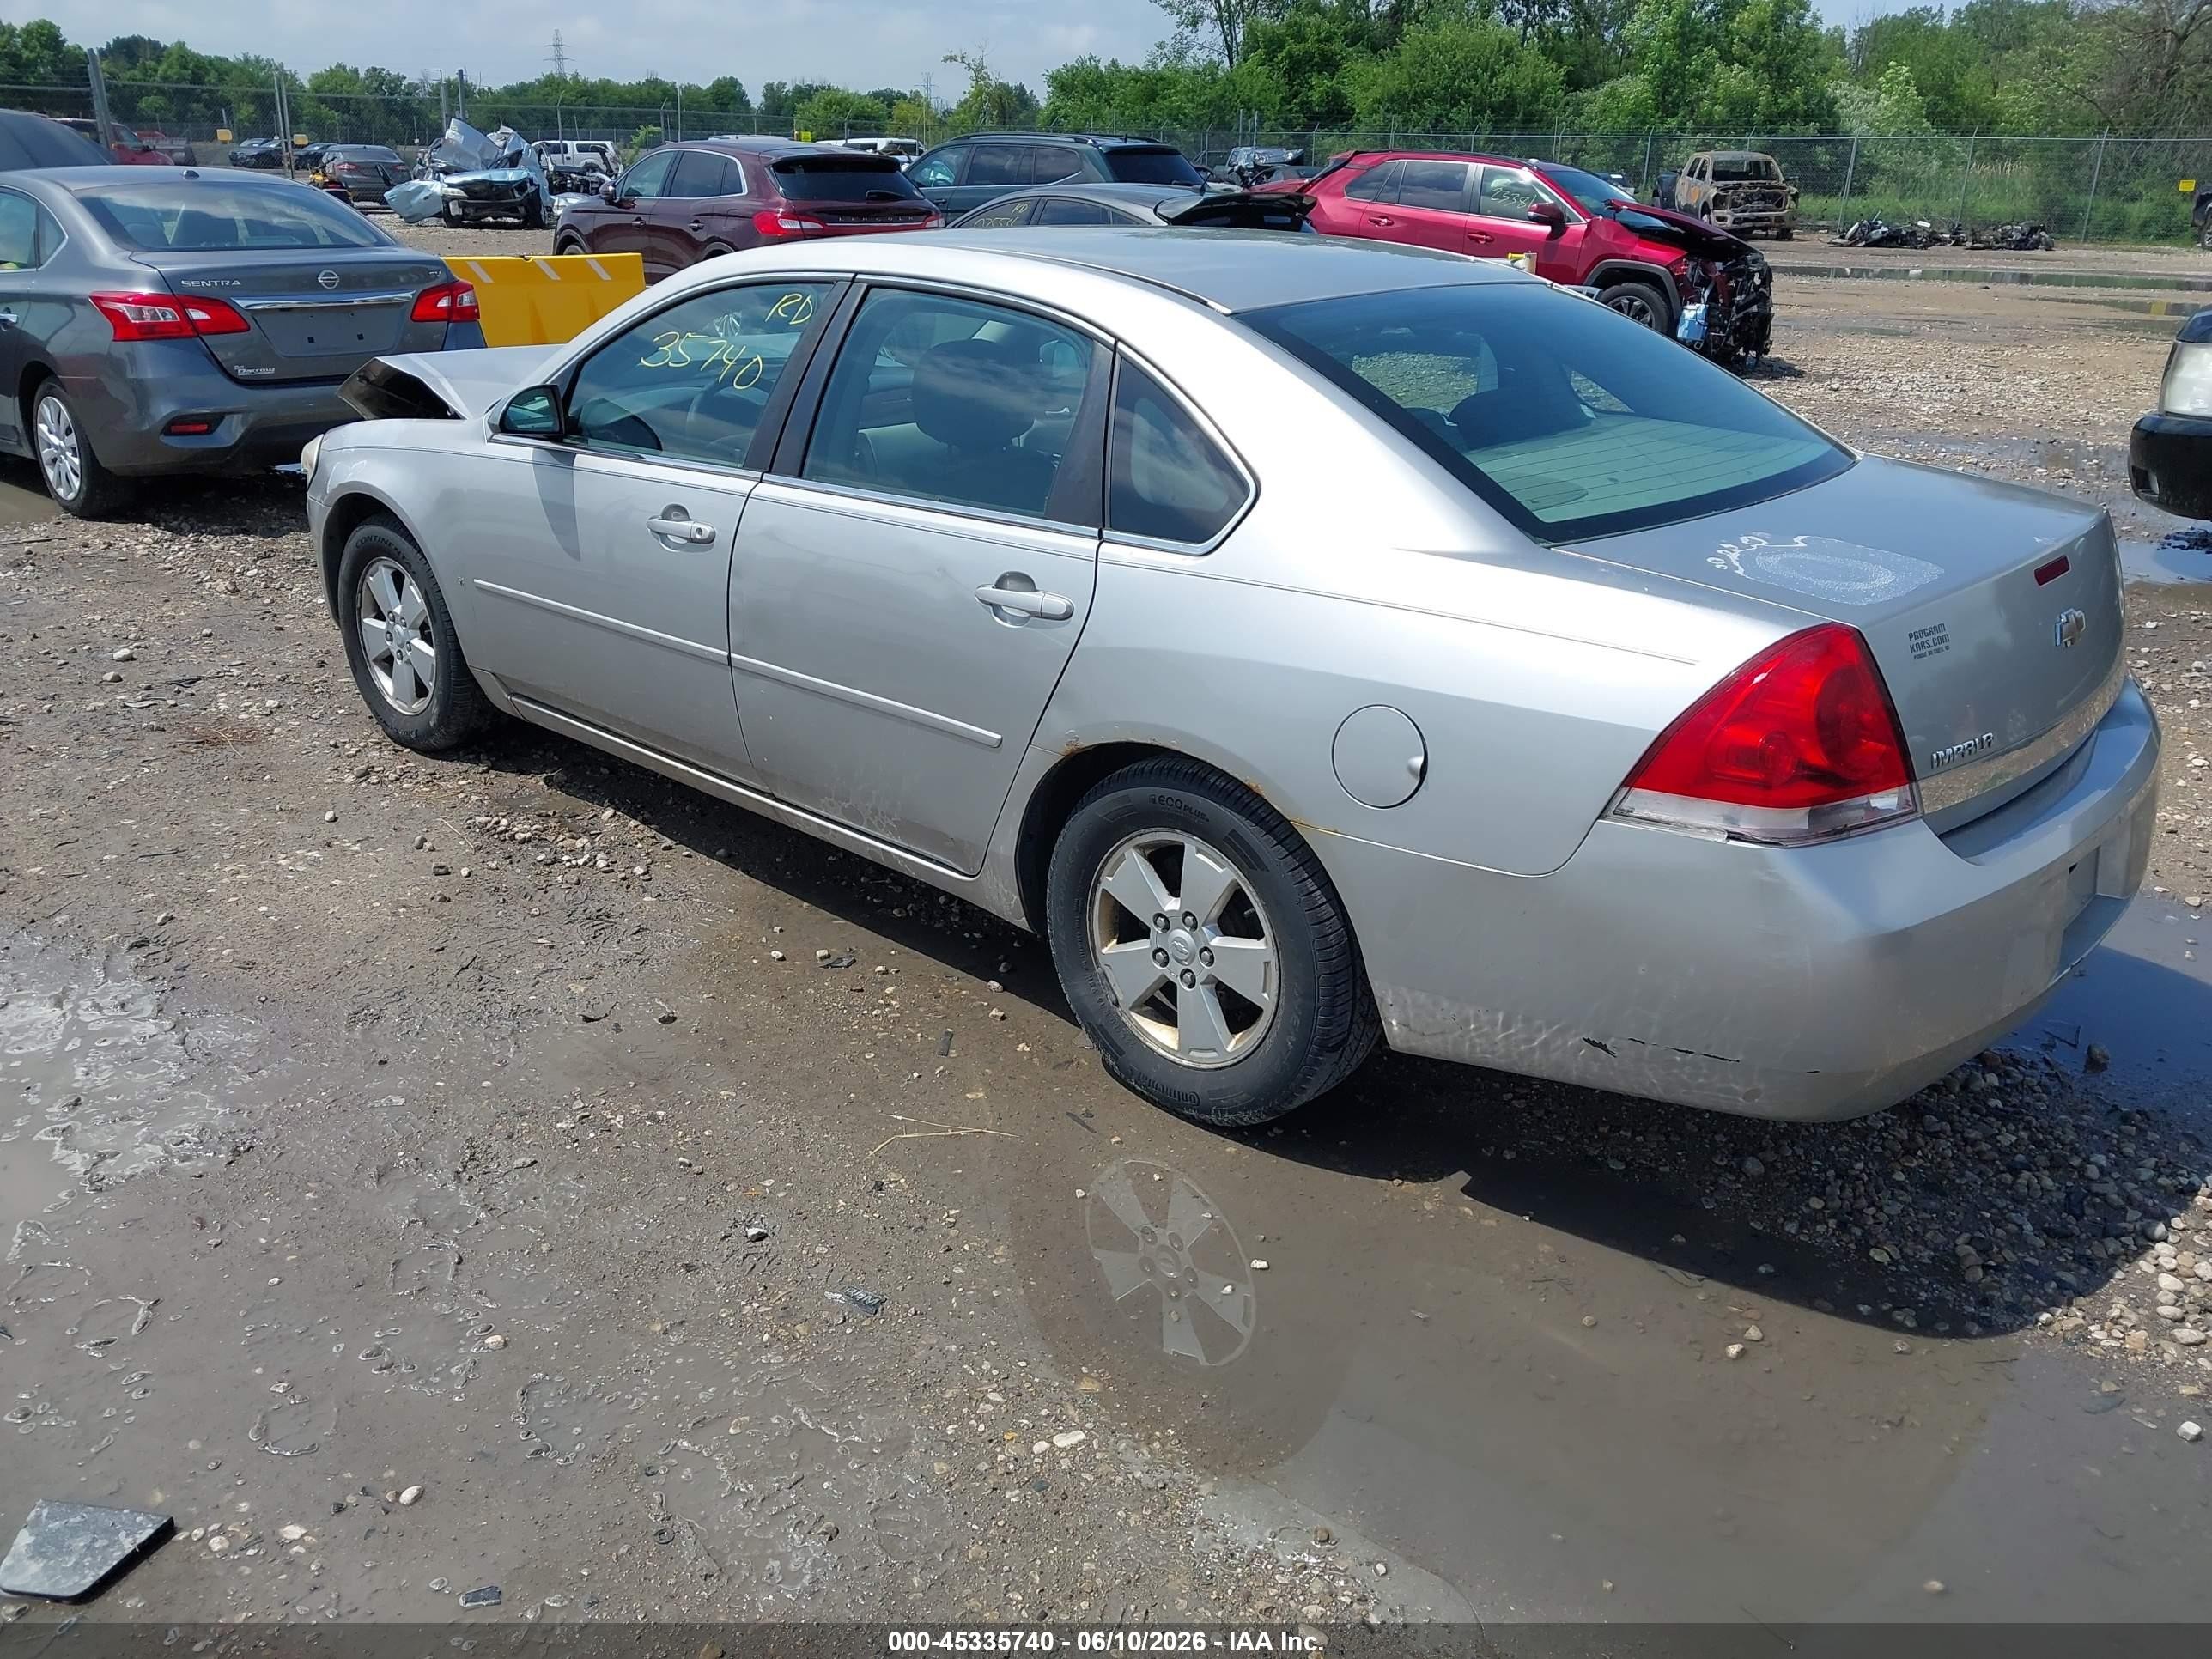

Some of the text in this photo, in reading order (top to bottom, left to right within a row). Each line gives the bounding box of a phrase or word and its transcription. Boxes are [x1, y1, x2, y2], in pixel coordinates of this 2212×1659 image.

[180, 279, 242, 288] SENTRA
[764, 293, 814, 325] RD
[640, 331, 764, 390] 35740
[1908, 623, 1946, 641] PROGRAM
[1909, 633, 1950, 653] KARS.COM
[1930, 732, 1993, 769] IMPALA
